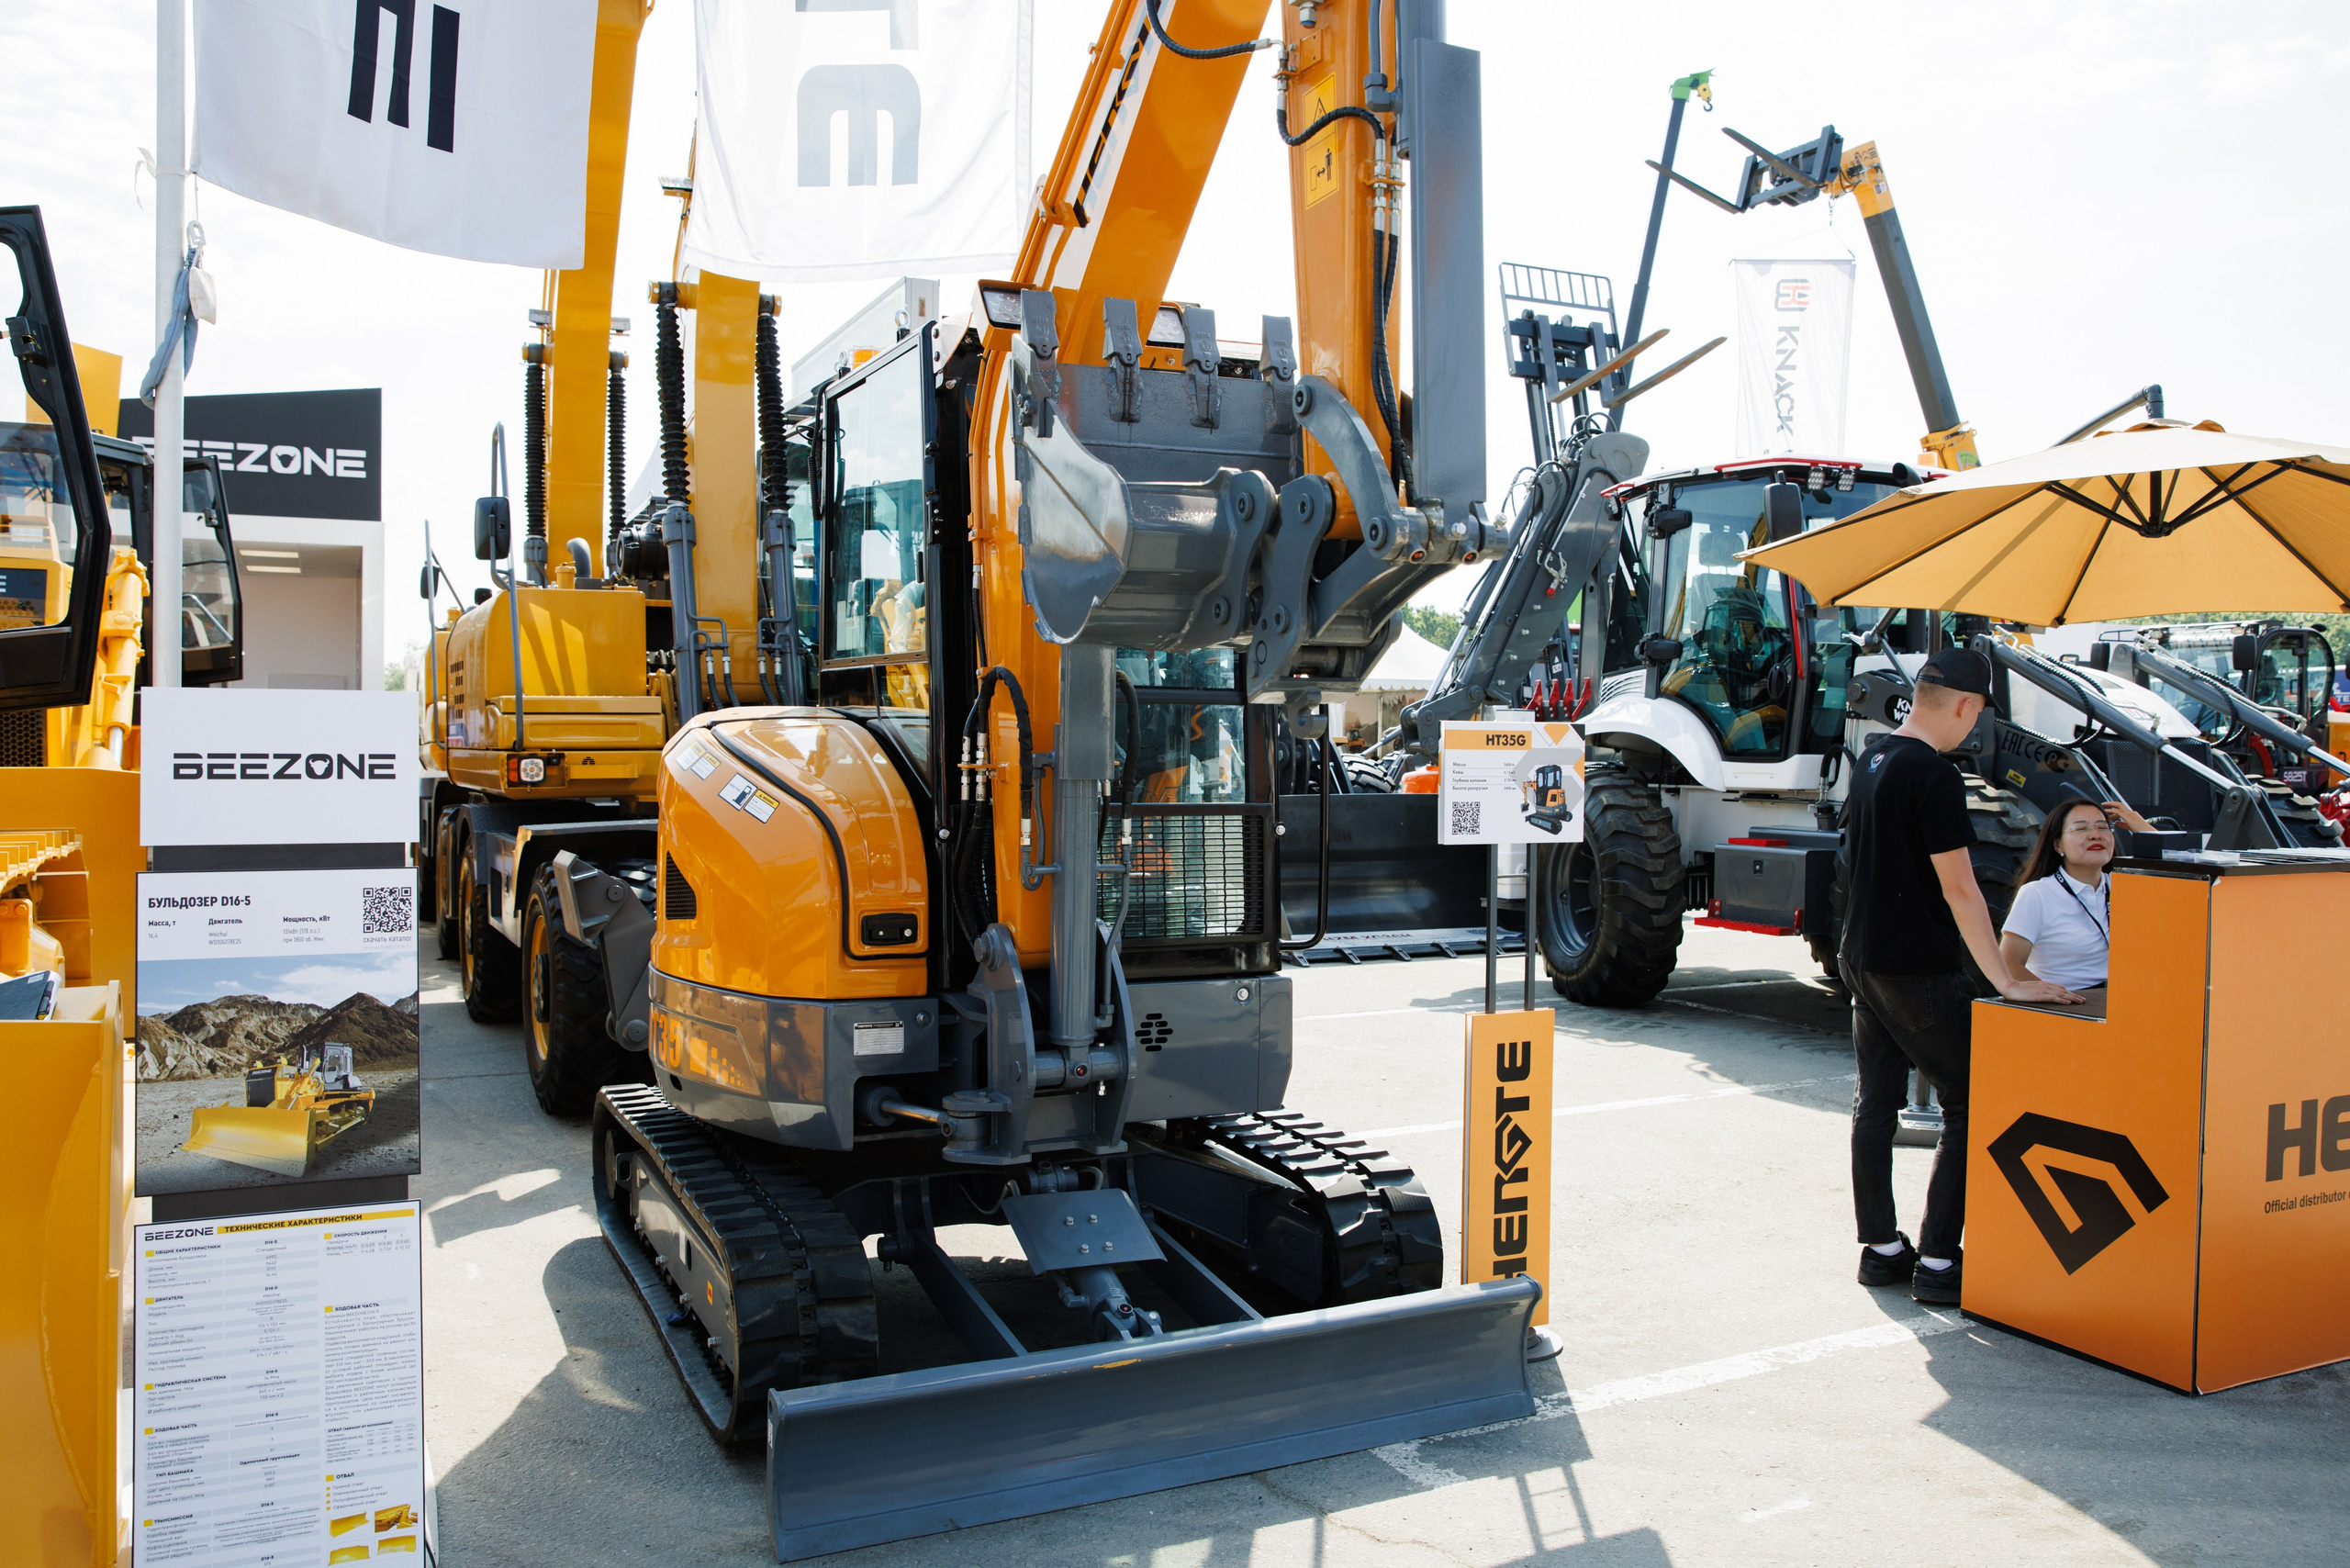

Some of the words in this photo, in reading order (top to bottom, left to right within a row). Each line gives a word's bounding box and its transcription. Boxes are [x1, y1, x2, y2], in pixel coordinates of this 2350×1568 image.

[1774, 326, 1800, 436] KNACK
[1486, 734, 1526, 746] HT35G
[173, 752, 396, 780] BEEZONE
[148, 896, 218, 909] БУЛЬДОЗЕР
[221, 896, 251, 907] D16-5
[2264, 1197, 2297, 1214] Official
[2300, 1190, 2346, 1208] distributor
[225, 1221, 285, 1233] ТЕХНИЧЕСКИЕ
[288, 1214, 362, 1227] ХАРАКТЕРИСТИКИ
[145, 1227, 214, 1241] BEEZONE
[155, 1378, 201, 1388] ГИДРАВЛИЧЕСКАЯ
[154, 1514, 193, 1523] ТРАНСМИССИЯ
